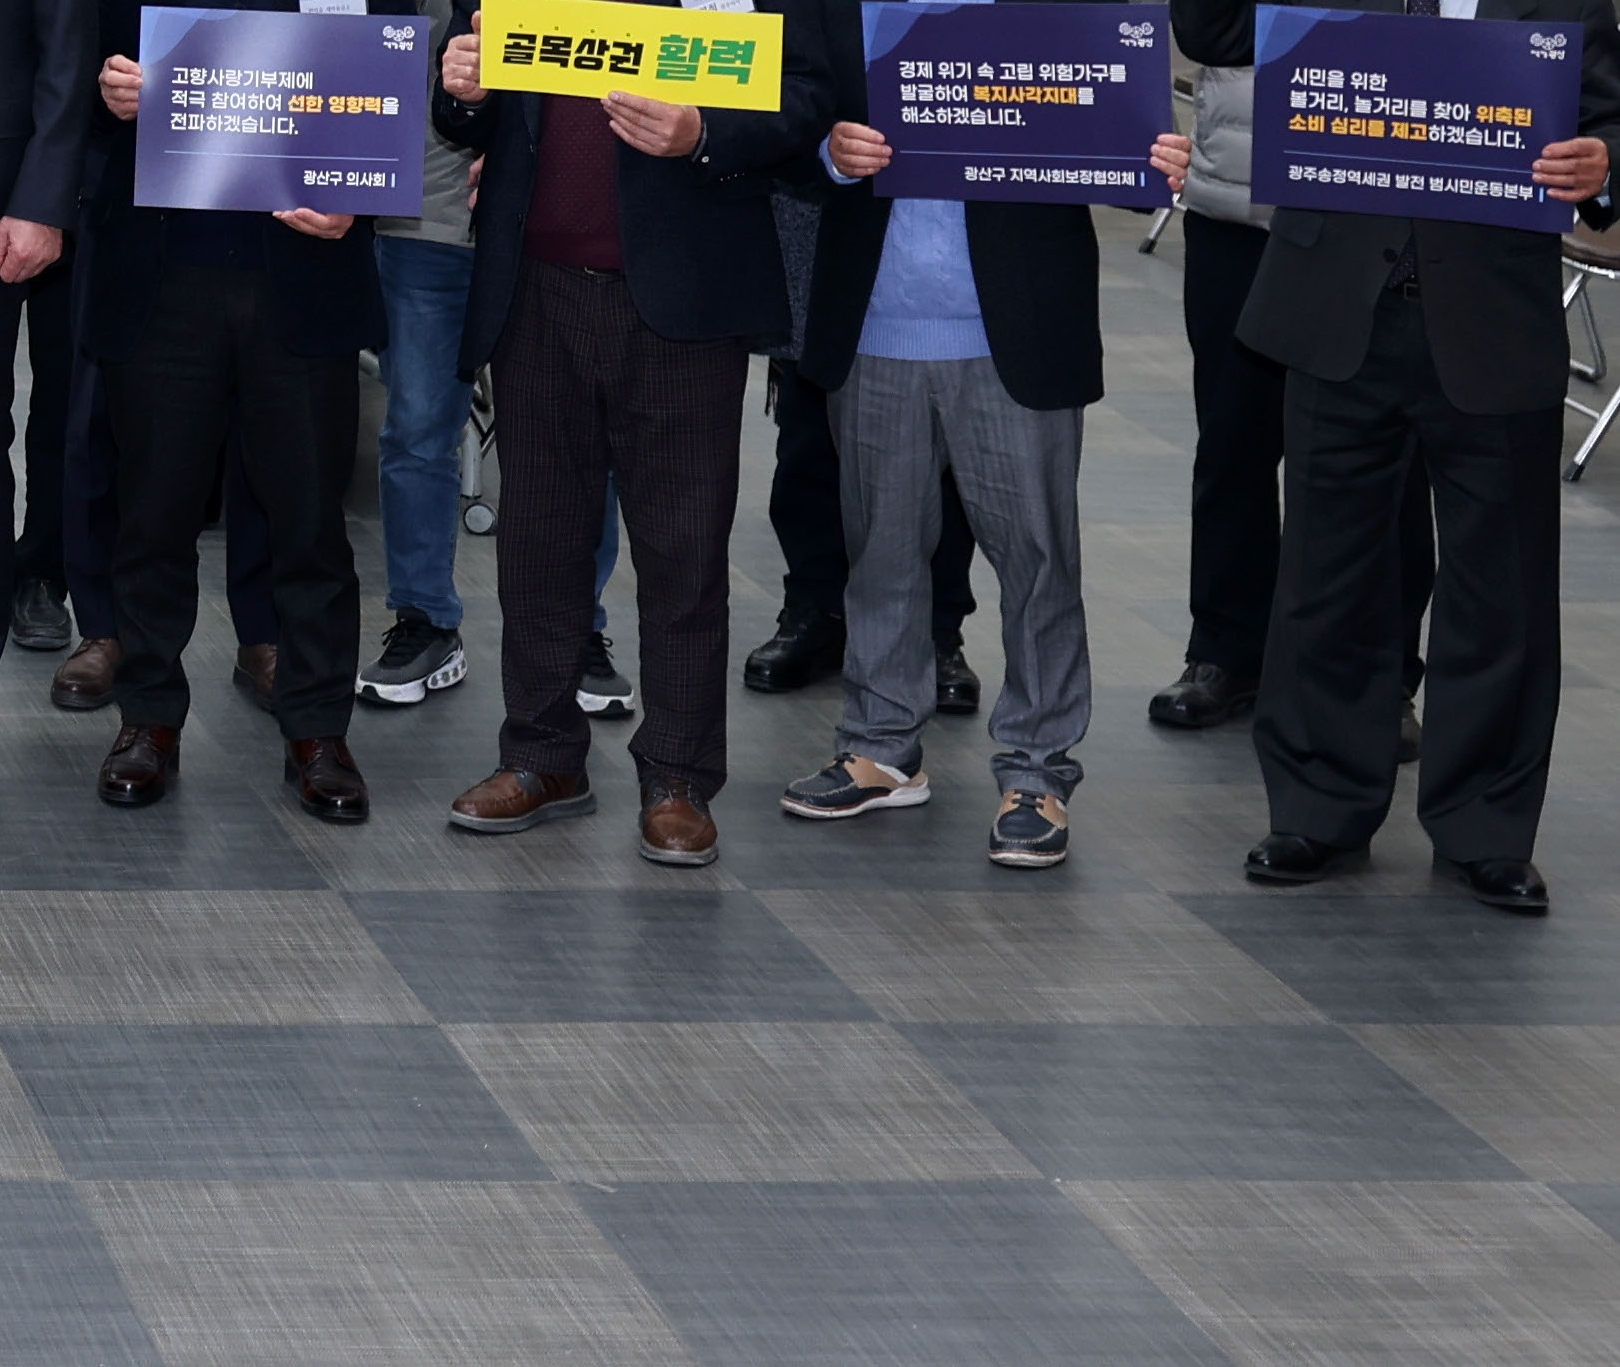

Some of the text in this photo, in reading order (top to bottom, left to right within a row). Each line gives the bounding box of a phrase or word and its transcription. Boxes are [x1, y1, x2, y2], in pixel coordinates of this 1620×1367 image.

[501, 30, 759, 85] 골목상권 활력
[171, 67, 314, 90] 고향사랑기부제에
[899, 61, 1127, 83] 경제 위기 속 고립 위험가구를
[1290, 67, 1388, 92] 시민을 위한
[171, 90, 400, 116] 적극 참여하여 선한 영향력을
[900, 84, 1095, 105] 발굴하여 복지사각지대를
[901, 106, 1027, 127] 해소하겠습니다.
[1290, 90, 1533, 127] 볼거리, 놀거리를 찾아 위축된
[170, 113, 299, 136] 전파하겠습니다.
[1288, 113, 1526, 150] 소비 심리를 제고하겠습니다.
[303, 170, 386, 188] 광산구 의사회
[964, 166, 1136, 186] 광산구 지역사회보장협의체
[1288, 165, 1534, 201] 광주송정역세권 발전 범시민운동본부
